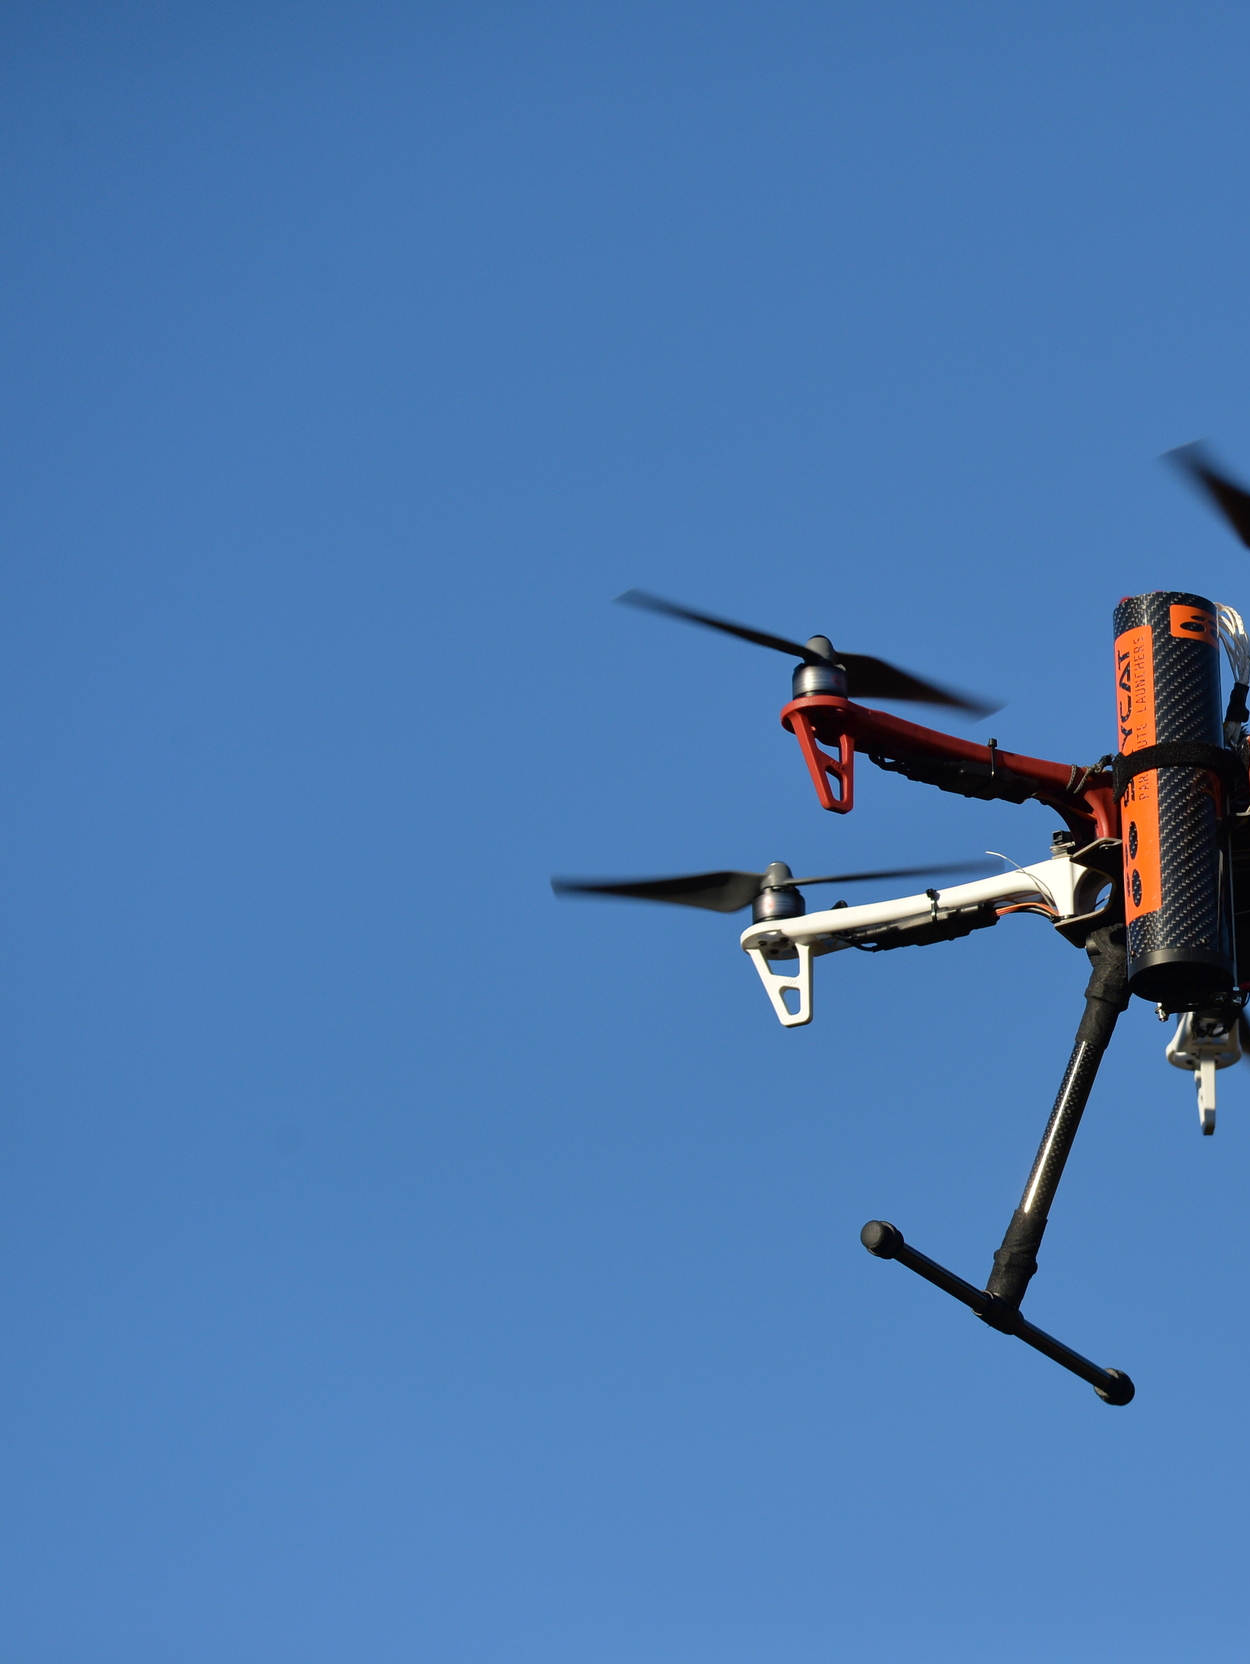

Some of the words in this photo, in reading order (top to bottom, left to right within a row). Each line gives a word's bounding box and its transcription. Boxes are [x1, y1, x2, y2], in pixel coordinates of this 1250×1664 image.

[1132, 636, 1147, 713] LAUNCHERS
[1117, 650, 1136, 808] SYCAT
[1136, 723, 1150, 801] PARUTE
